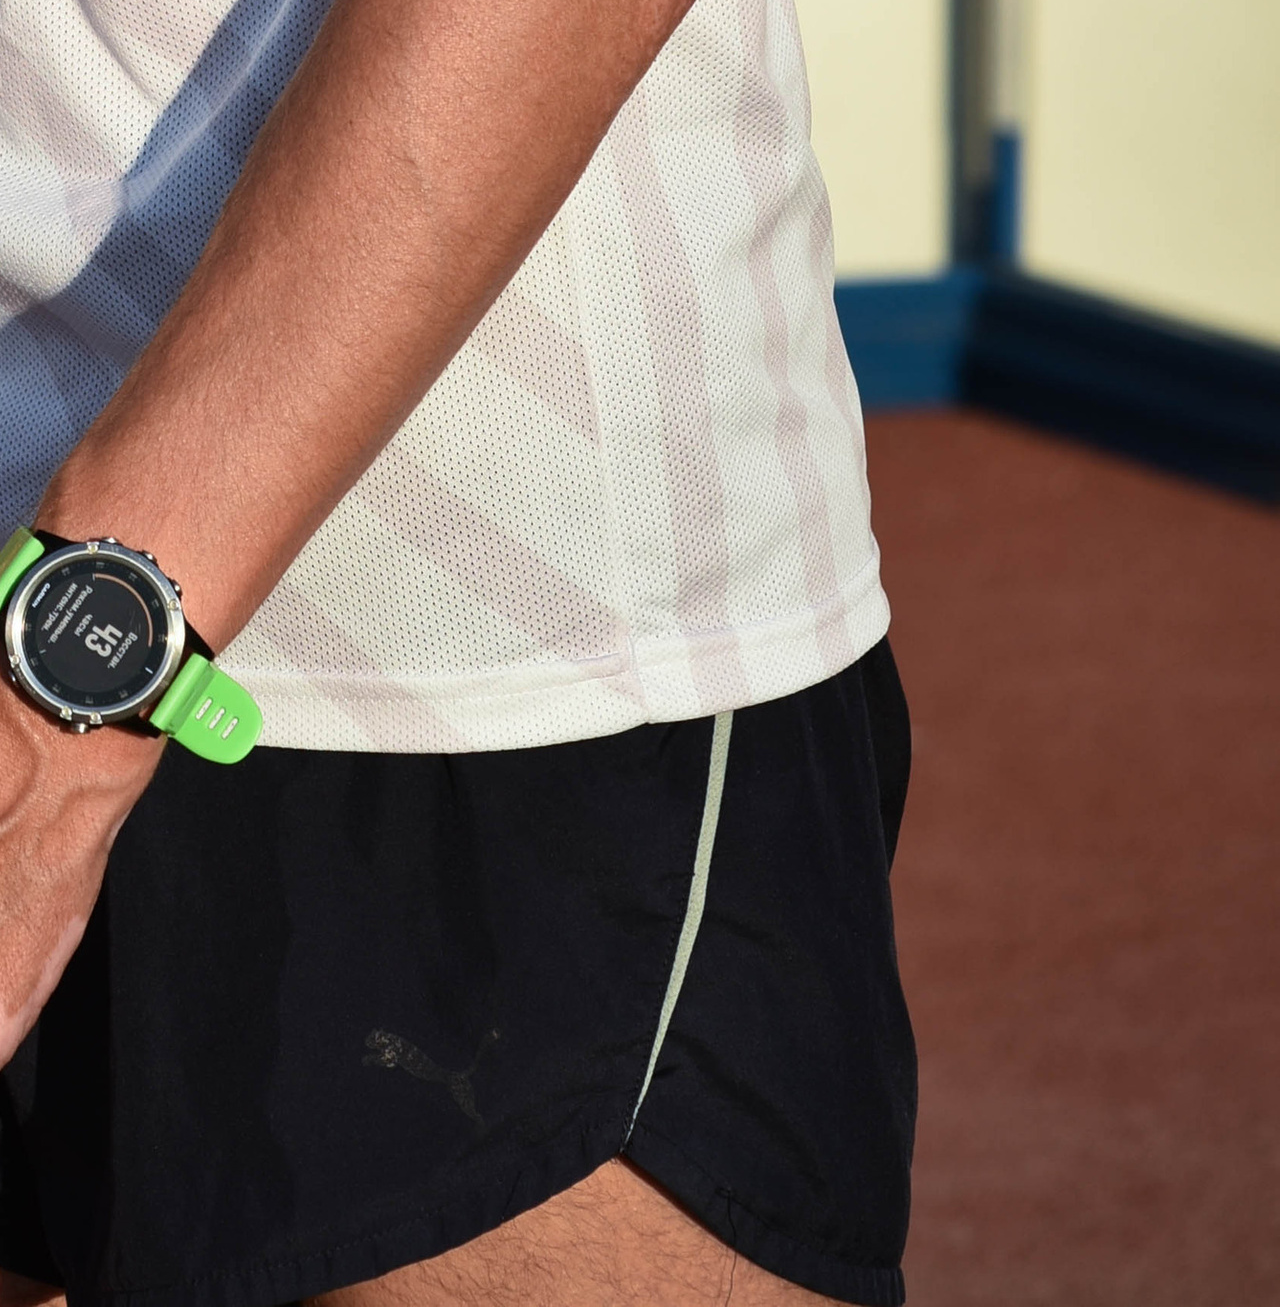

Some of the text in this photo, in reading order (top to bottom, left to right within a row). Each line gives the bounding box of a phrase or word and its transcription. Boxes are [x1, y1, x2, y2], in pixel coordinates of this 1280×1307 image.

[31, 582, 51, 608] GARMIN
[74, 613, 93, 637] часы
[84, 623, 123, 657] 43
[107, 631, 138, 669] Восстан.
